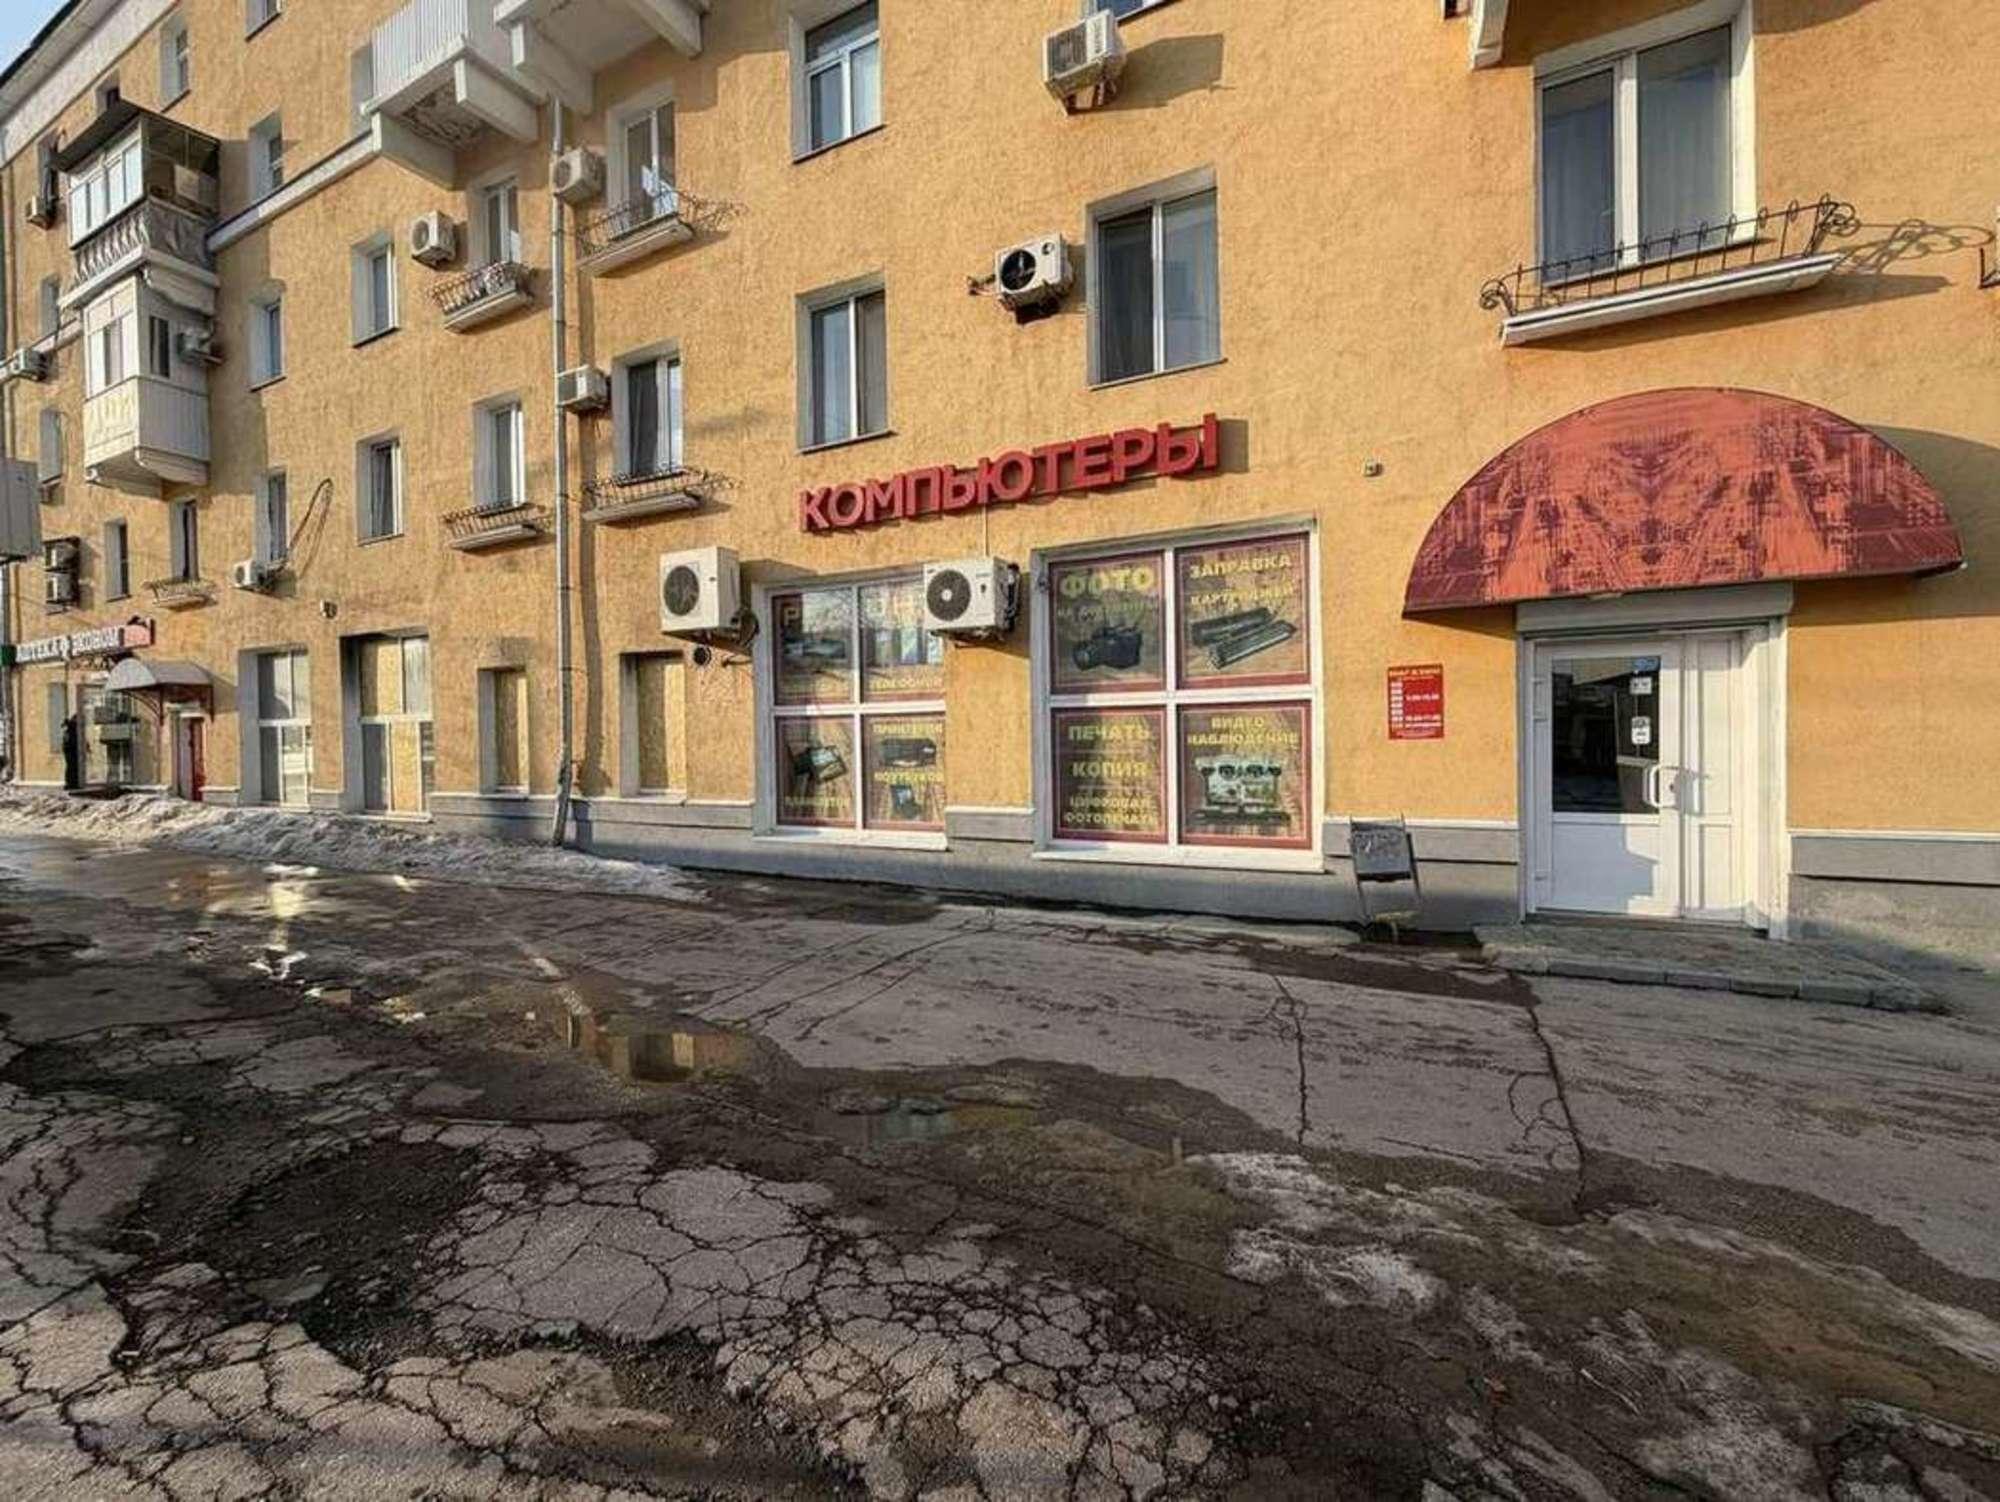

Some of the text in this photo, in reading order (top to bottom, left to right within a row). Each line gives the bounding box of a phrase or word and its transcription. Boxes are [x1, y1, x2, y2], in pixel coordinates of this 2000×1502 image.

[801, 412, 1220, 531] КОМПЬЮТЕРЫ
[1189, 554, 1293, 579] ЗАПРАВКА
[1060, 566, 1156, 598] ФОТО
[1211, 716, 1265, 728] ВИДЕО
[1068, 724, 1150, 741] ПЕЧАТЬ
[1187, 732, 1298, 745] НАБЛЮДЕНИЕ
[1072, 761, 1149, 777] КОПИЯ
[1064, 811, 1159, 826] ФОТОПЕЧАТЬ
